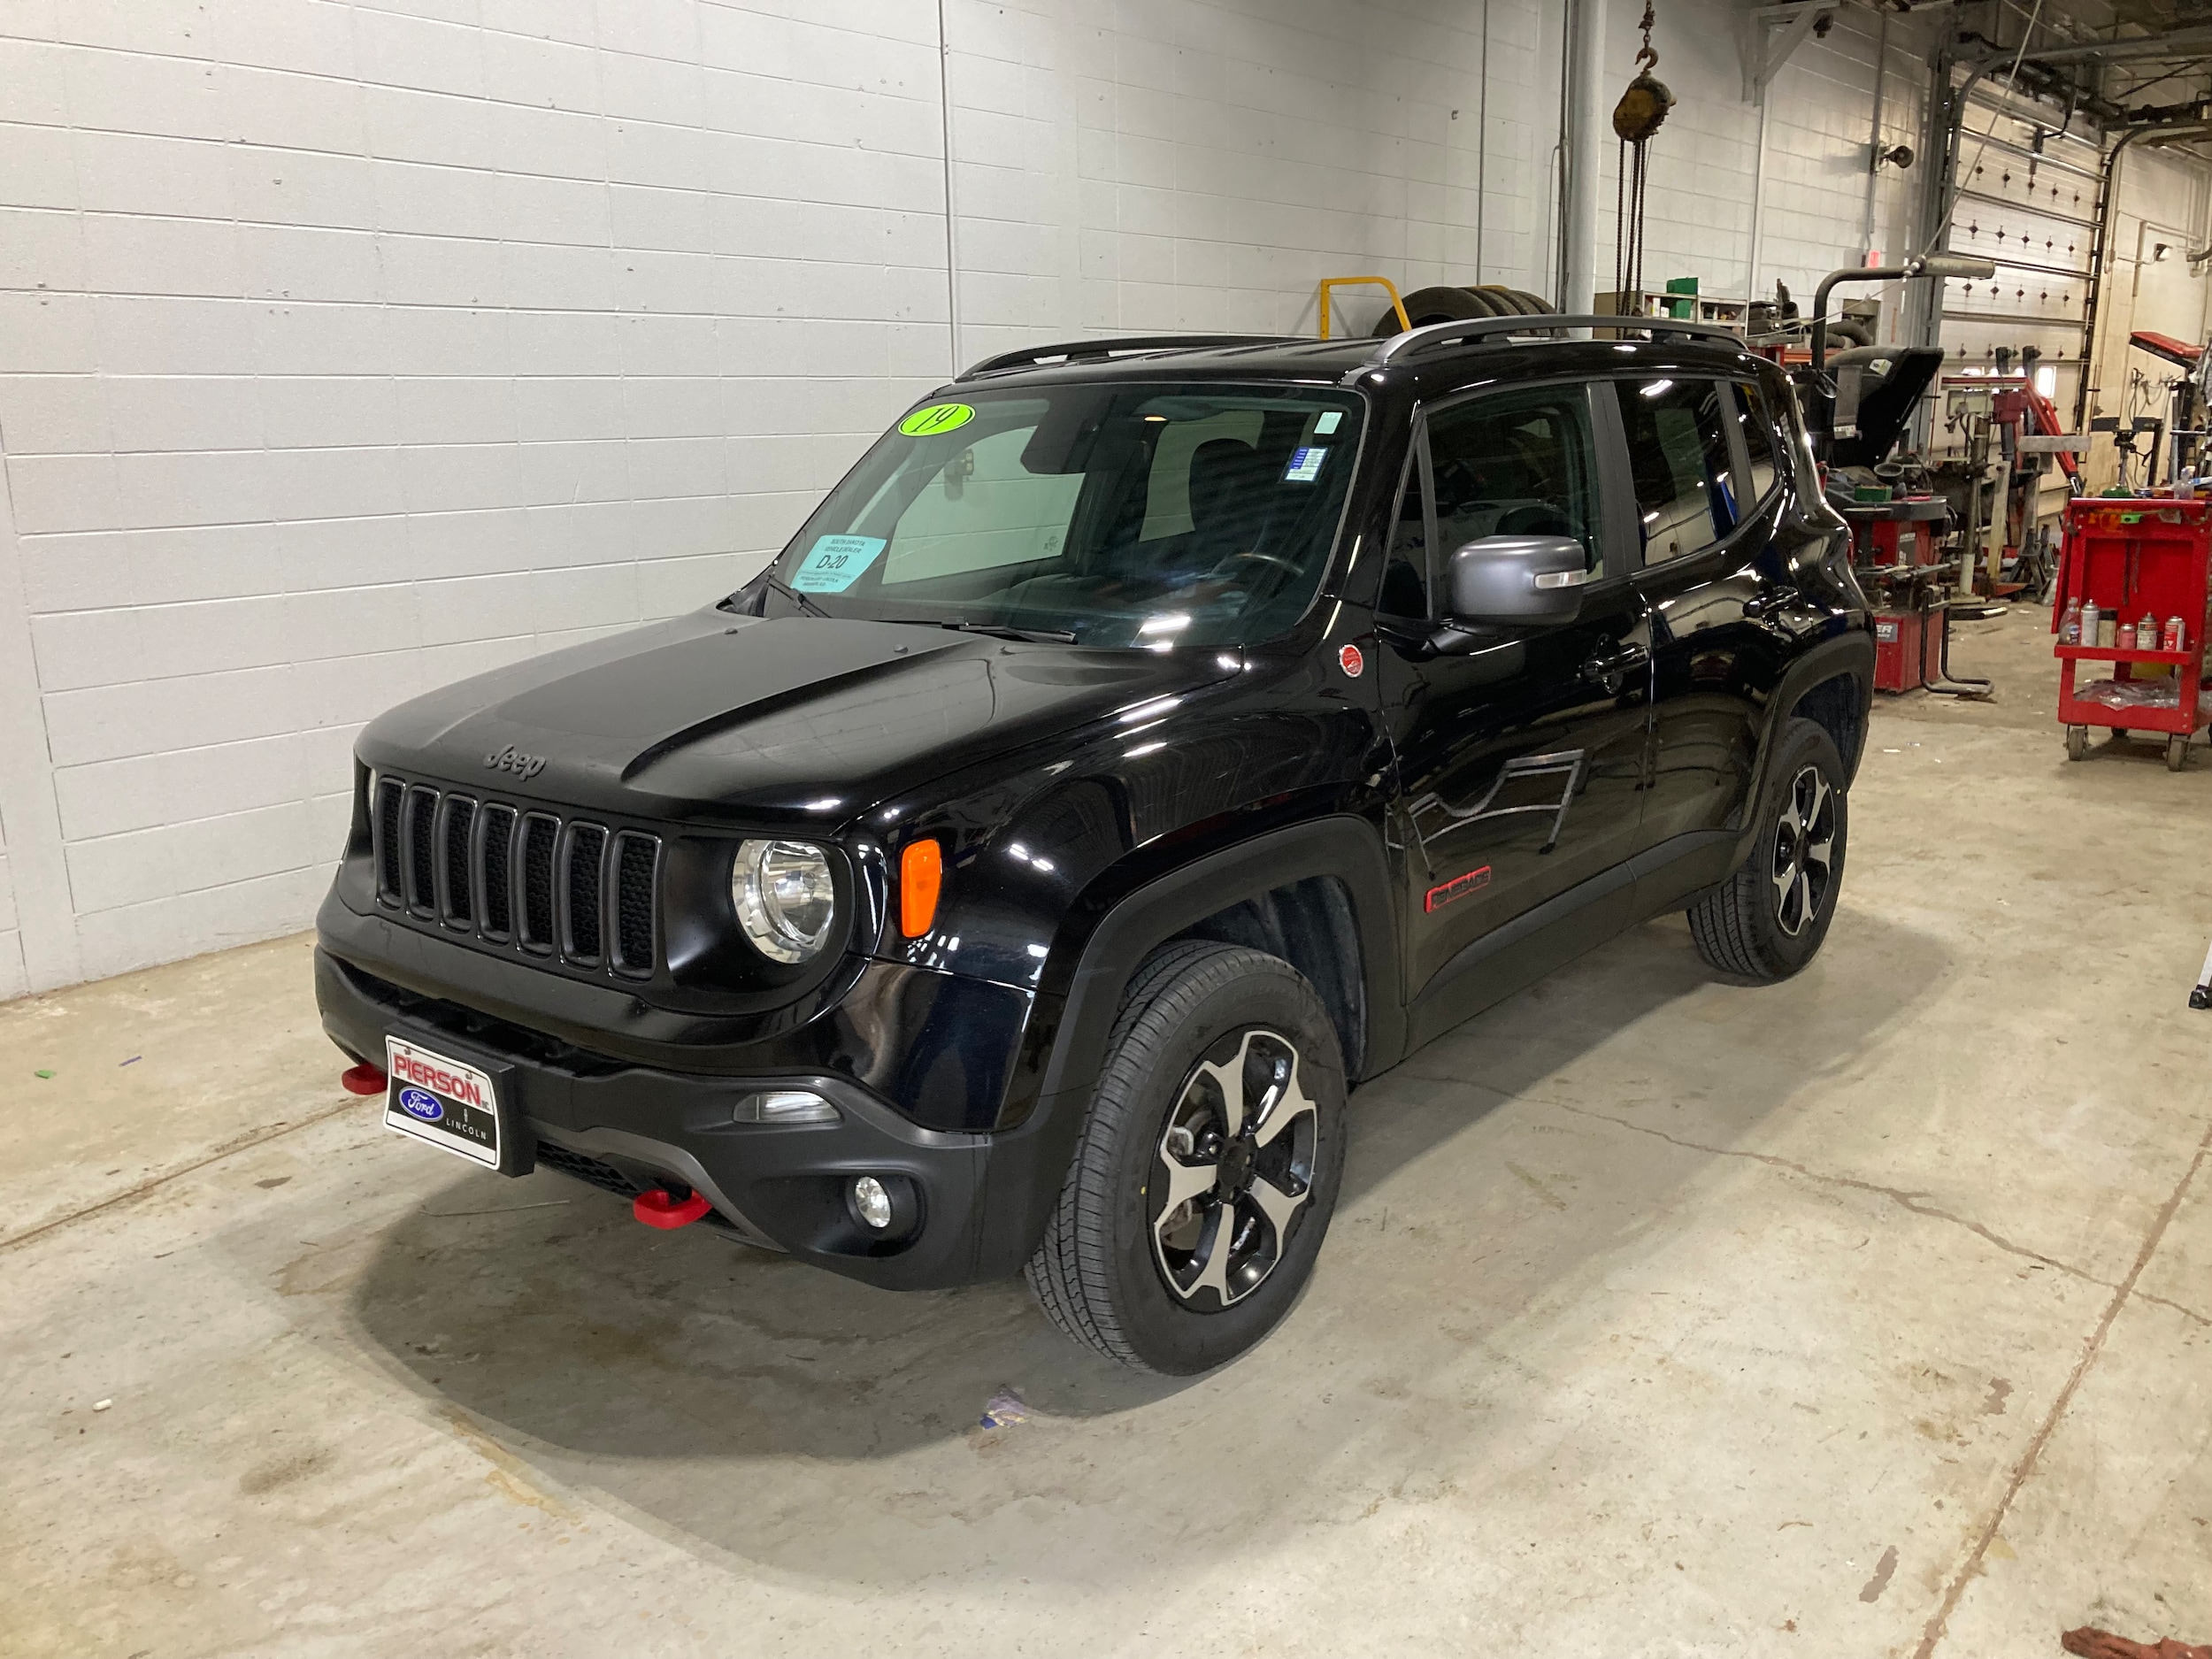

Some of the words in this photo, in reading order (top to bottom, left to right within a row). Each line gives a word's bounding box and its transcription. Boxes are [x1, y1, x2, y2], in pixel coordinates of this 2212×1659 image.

[907, 405, 960, 433] 19
[482, 744, 547, 782] Jeep
[393, 1052, 482, 1107] PIERSON
[407, 1091, 435, 1117] Ford
[445, 1117, 488, 1141] LINCOLN
